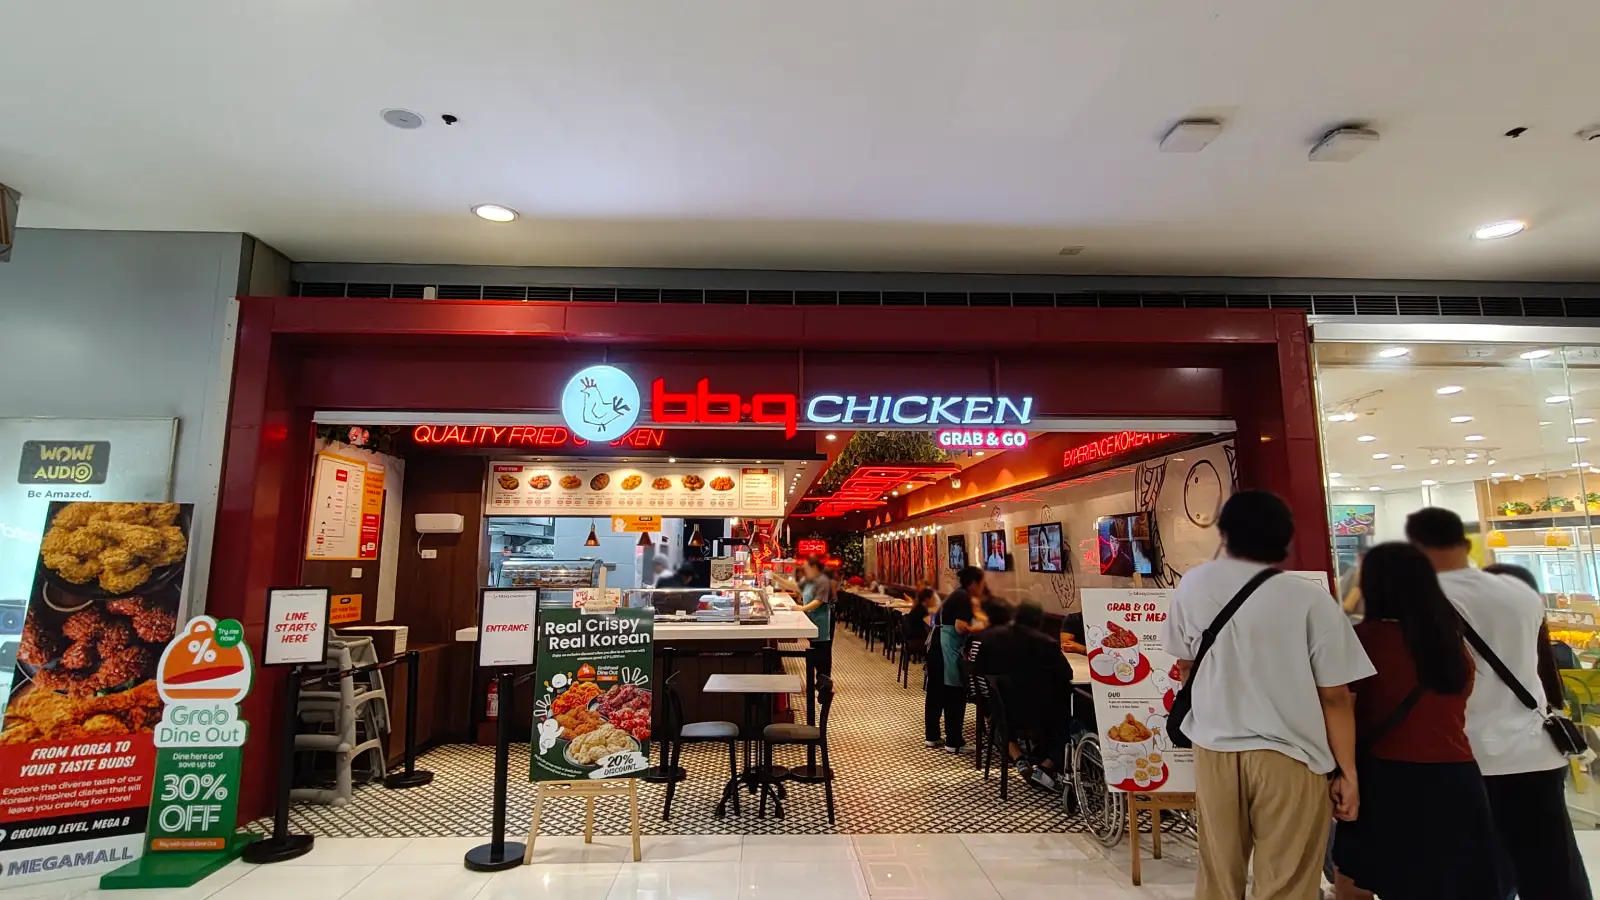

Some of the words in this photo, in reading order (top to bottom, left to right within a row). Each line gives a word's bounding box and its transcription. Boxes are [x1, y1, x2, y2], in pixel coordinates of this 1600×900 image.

[806, 395, 1034, 425] CHICKEN
[414, 425, 507, 444] QUALITY
[508, 426, 568, 445] FRIED
[573, 429, 664, 447] CKEN
[939, 432, 984, 446] GRAB
[986, 432, 999, 446] &
[1002, 432, 1027, 446] GO
[38, 444, 95, 461] WOW!
[1063, 436, 1114, 468] EXPERIENCE
[33, 462, 94, 483] AUDIO
[28, 490, 42, 498] Be
[44, 490, 92, 498] Amazed.
[1134, 602, 1141, 611] &
[285, 611, 309, 621] LINE
[1124, 612, 1142, 622] SET
[1145, 612, 1167, 622] MEA
[217, 628, 228, 636] Try
[274, 622, 318, 633] STARTS
[485, 623, 530, 633] ENTRANCE
[544, 621, 582, 635] Real
[585, 617, 640, 634] Crispy
[281, 633, 309, 643] HERE
[549, 636, 586, 650] Real
[590, 632, 650, 647] Korean
[170, 704, 229, 726] Grab
[159, 727, 201, 743] Dine
[205, 728, 239, 742] Out
[30, 746, 70, 760] FROM
[70, 743, 112, 757] KOREA
[114, 741, 131, 753] TO
[172, 752, 190, 760] Dine
[190, 752, 207, 760] here
[208, 752, 223, 760] and
[20, 763, 57, 777] YOUR
[59, 759, 97, 774] TASTE
[97, 755, 136, 770] BUDS!
[607, 754, 634, 768] 20%
[0, 789, 77, 805] Korean-inspired
[78, 787, 108, 796] dishes
[109, 785, 127, 793] that
[127, 784, 141, 792] will
[2, 785, 39, 796] Explore
[41, 783, 57, 792] the
[58, 780, 92, 790] diverse
[93, 776, 116, 786] taste
[117, 775, 127, 783] of
[160, 773, 228, 801] 30%
[8, 803, 34, 814] leave
[35, 803, 53, 813] you
[54, 799, 89, 809] craving
[90, 796, 103, 804] for
[104, 794, 131, 803] more!
[159, 804, 222, 832] OFF
[10, 826, 56, 840] GROUND
[58, 820, 90, 835] LEVEL,
[92, 817, 120, 830] MEGA
[121, 816, 130, 827] B
[7, 847, 134, 876] MEGAMALL
